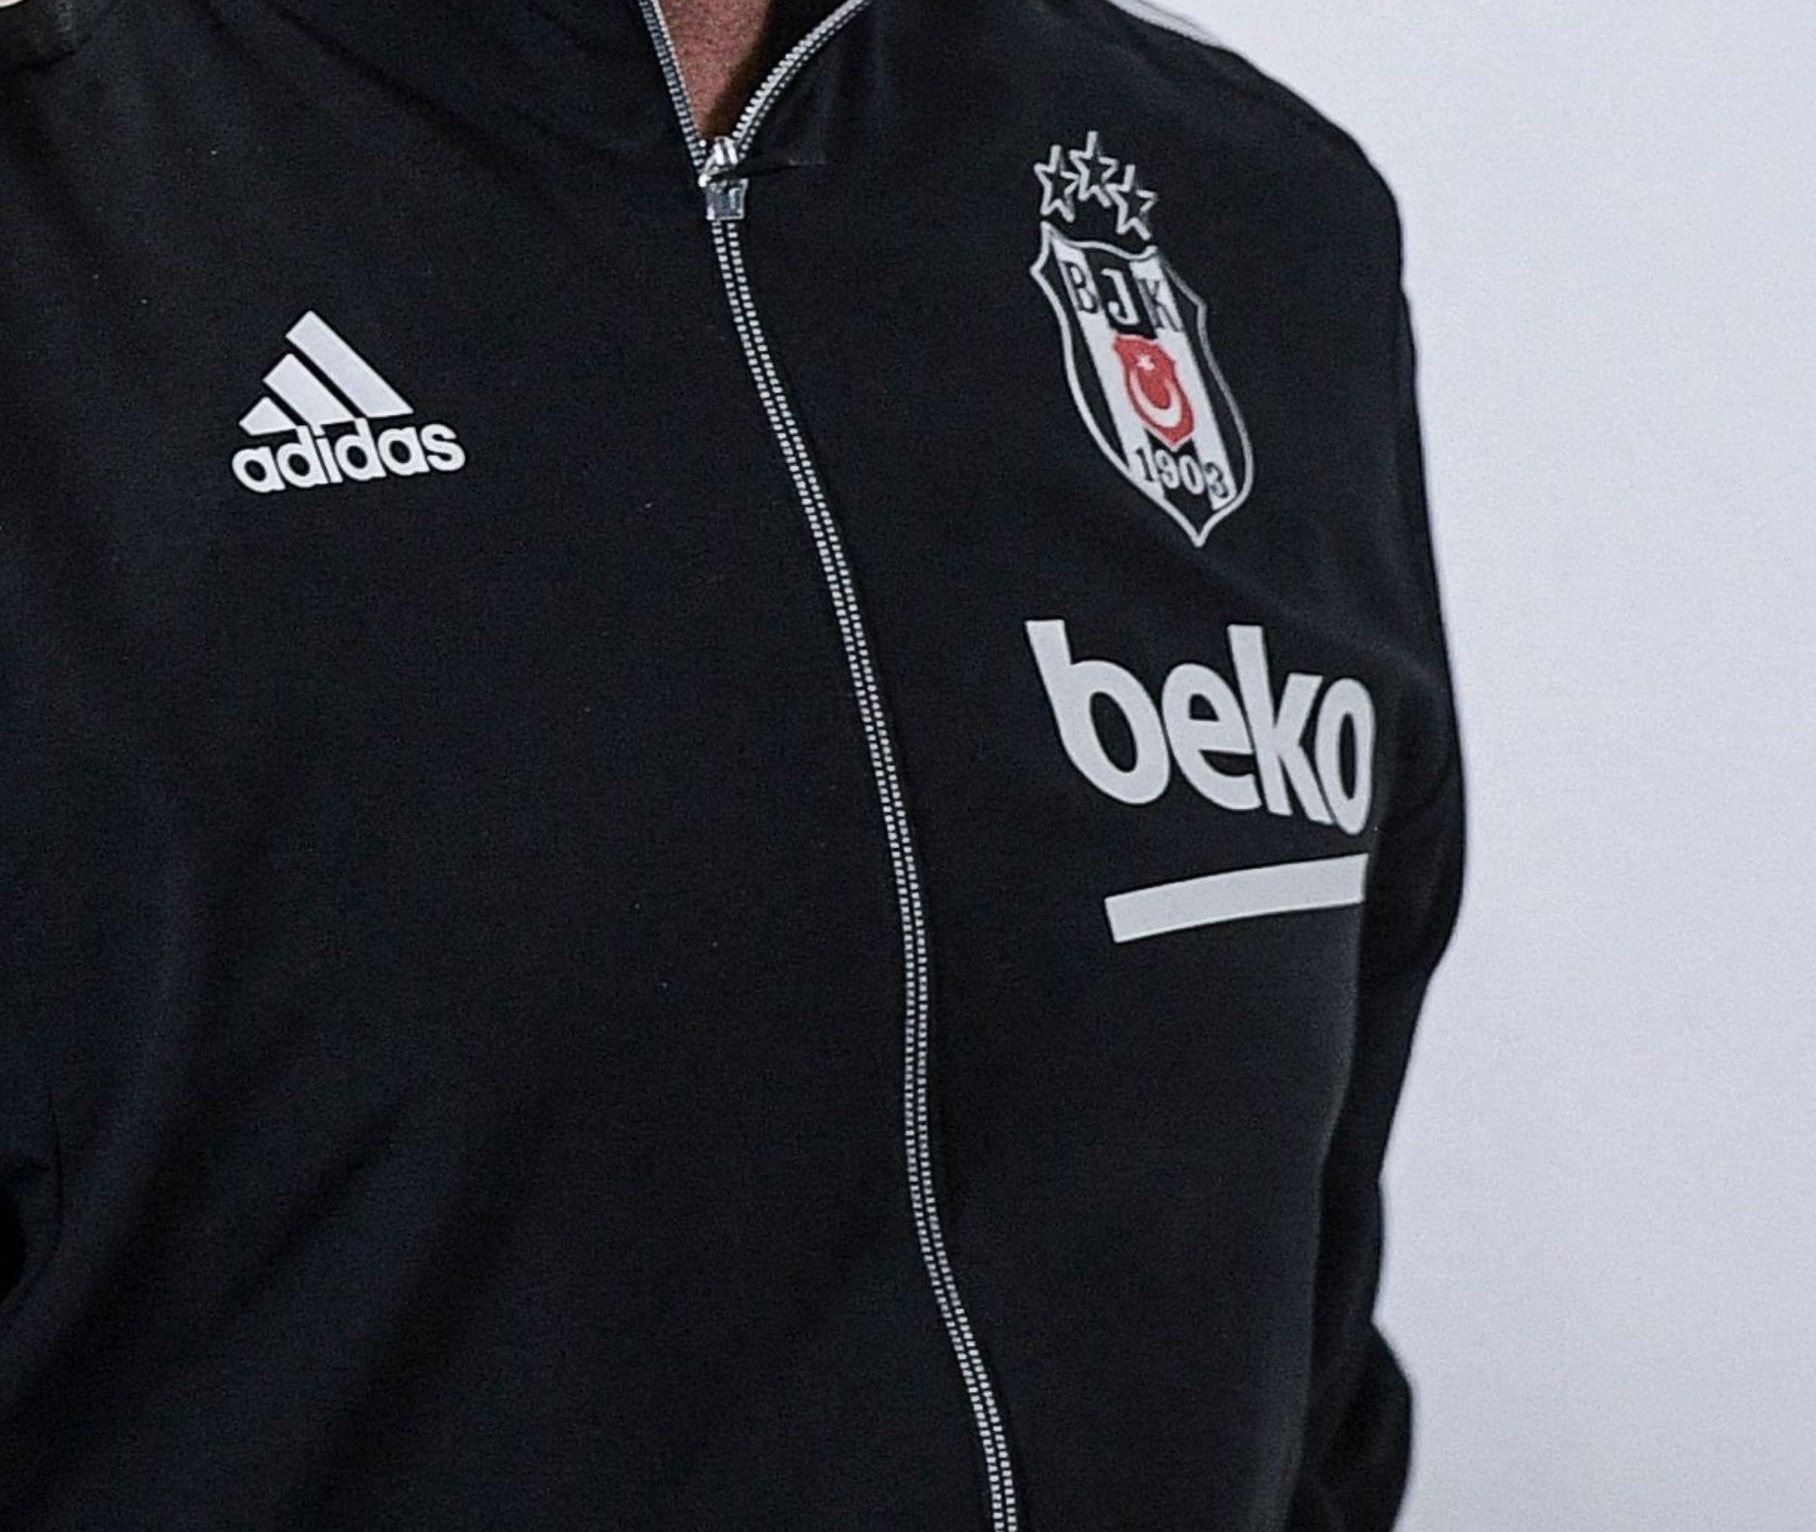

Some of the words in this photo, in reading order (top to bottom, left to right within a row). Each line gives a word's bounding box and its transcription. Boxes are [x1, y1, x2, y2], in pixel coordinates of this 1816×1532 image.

[1062, 260, 1185, 332] BJK
[231, 417, 466, 493] adidas
[1136, 447, 1229, 499] 1903
[1024, 619, 1375, 834] beko
